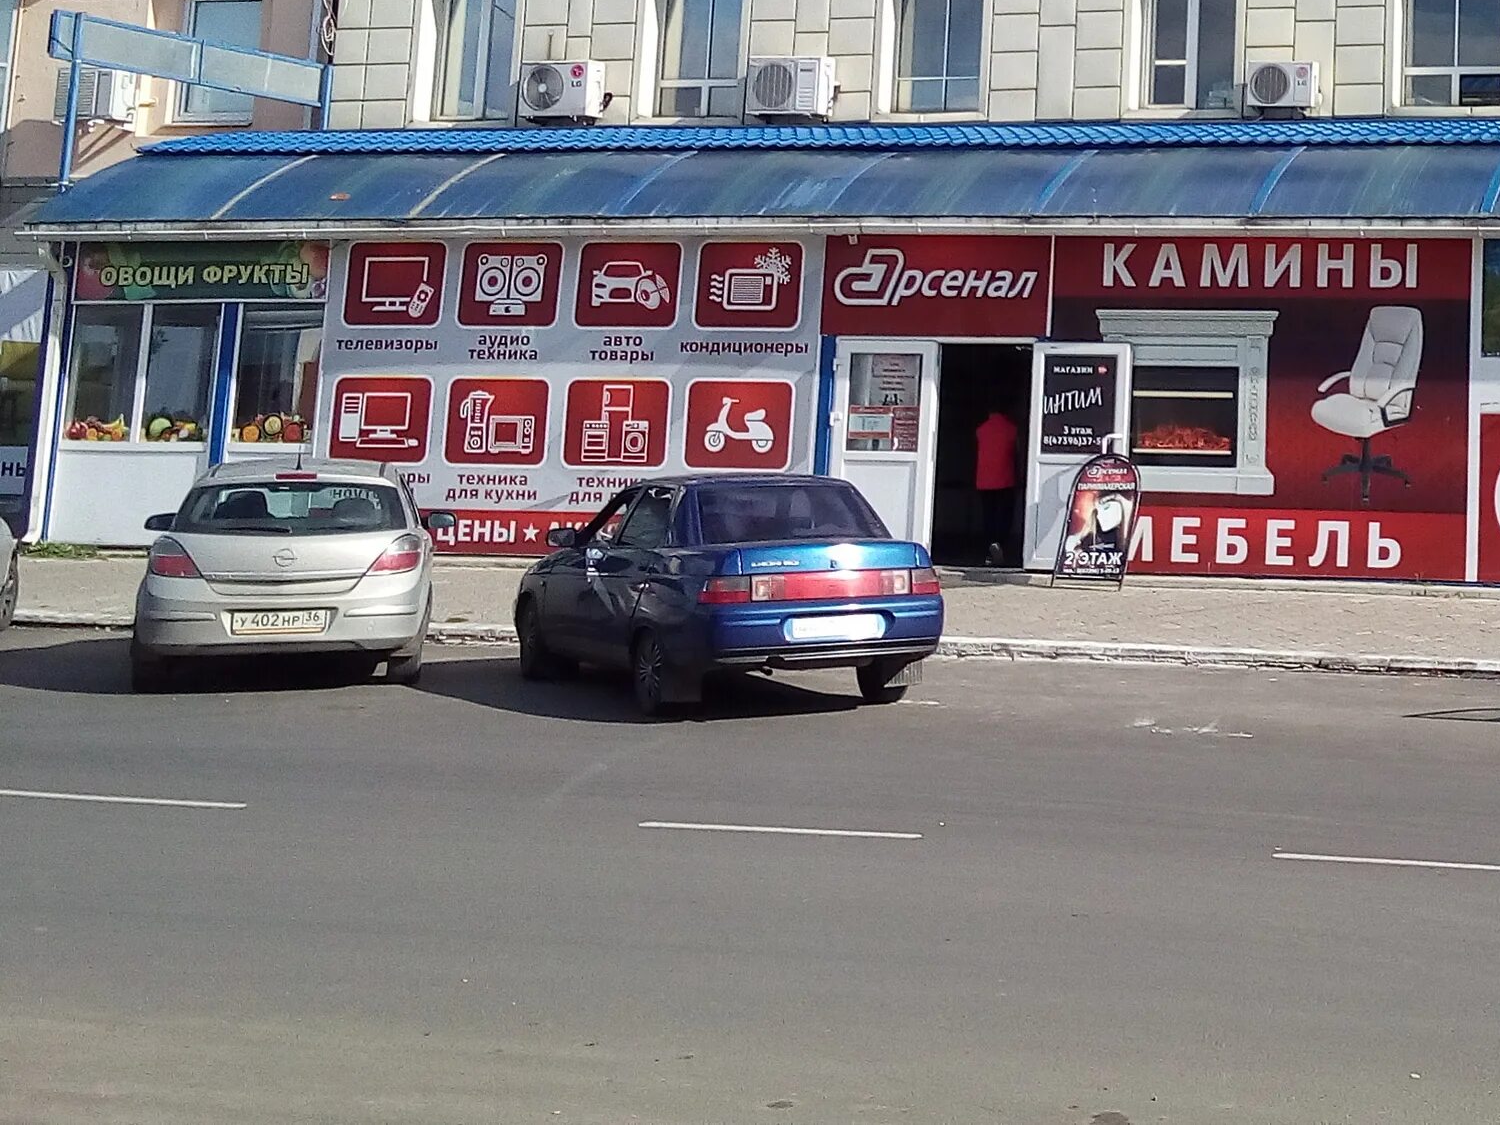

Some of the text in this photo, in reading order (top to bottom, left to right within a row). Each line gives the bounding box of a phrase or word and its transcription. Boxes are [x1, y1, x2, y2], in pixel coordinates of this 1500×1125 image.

[570, 80, 583, 88] LG
[1102, 242, 1418, 289] КАМИНЫ
[100, 263, 310, 289] ОВОЩИ ФРУКТЫ
[834, 247, 1039, 306] Арсенал
[336, 338, 438, 354] телевизоры
[478, 334, 531, 349] аудио
[603, 335, 644, 347] авто
[680, 340, 809, 357] кондиционеры
[468, 347, 539, 361] техника
[589, 349, 655, 364] товары
[457, 473, 528, 486] техника
[445, 487, 538, 505] для кухни
[568, 490, 603, 504] для
[436, 518, 517, 546] ЦЕНЫ
[1064, 551, 1123, 565] 2 ЭТАЖ
